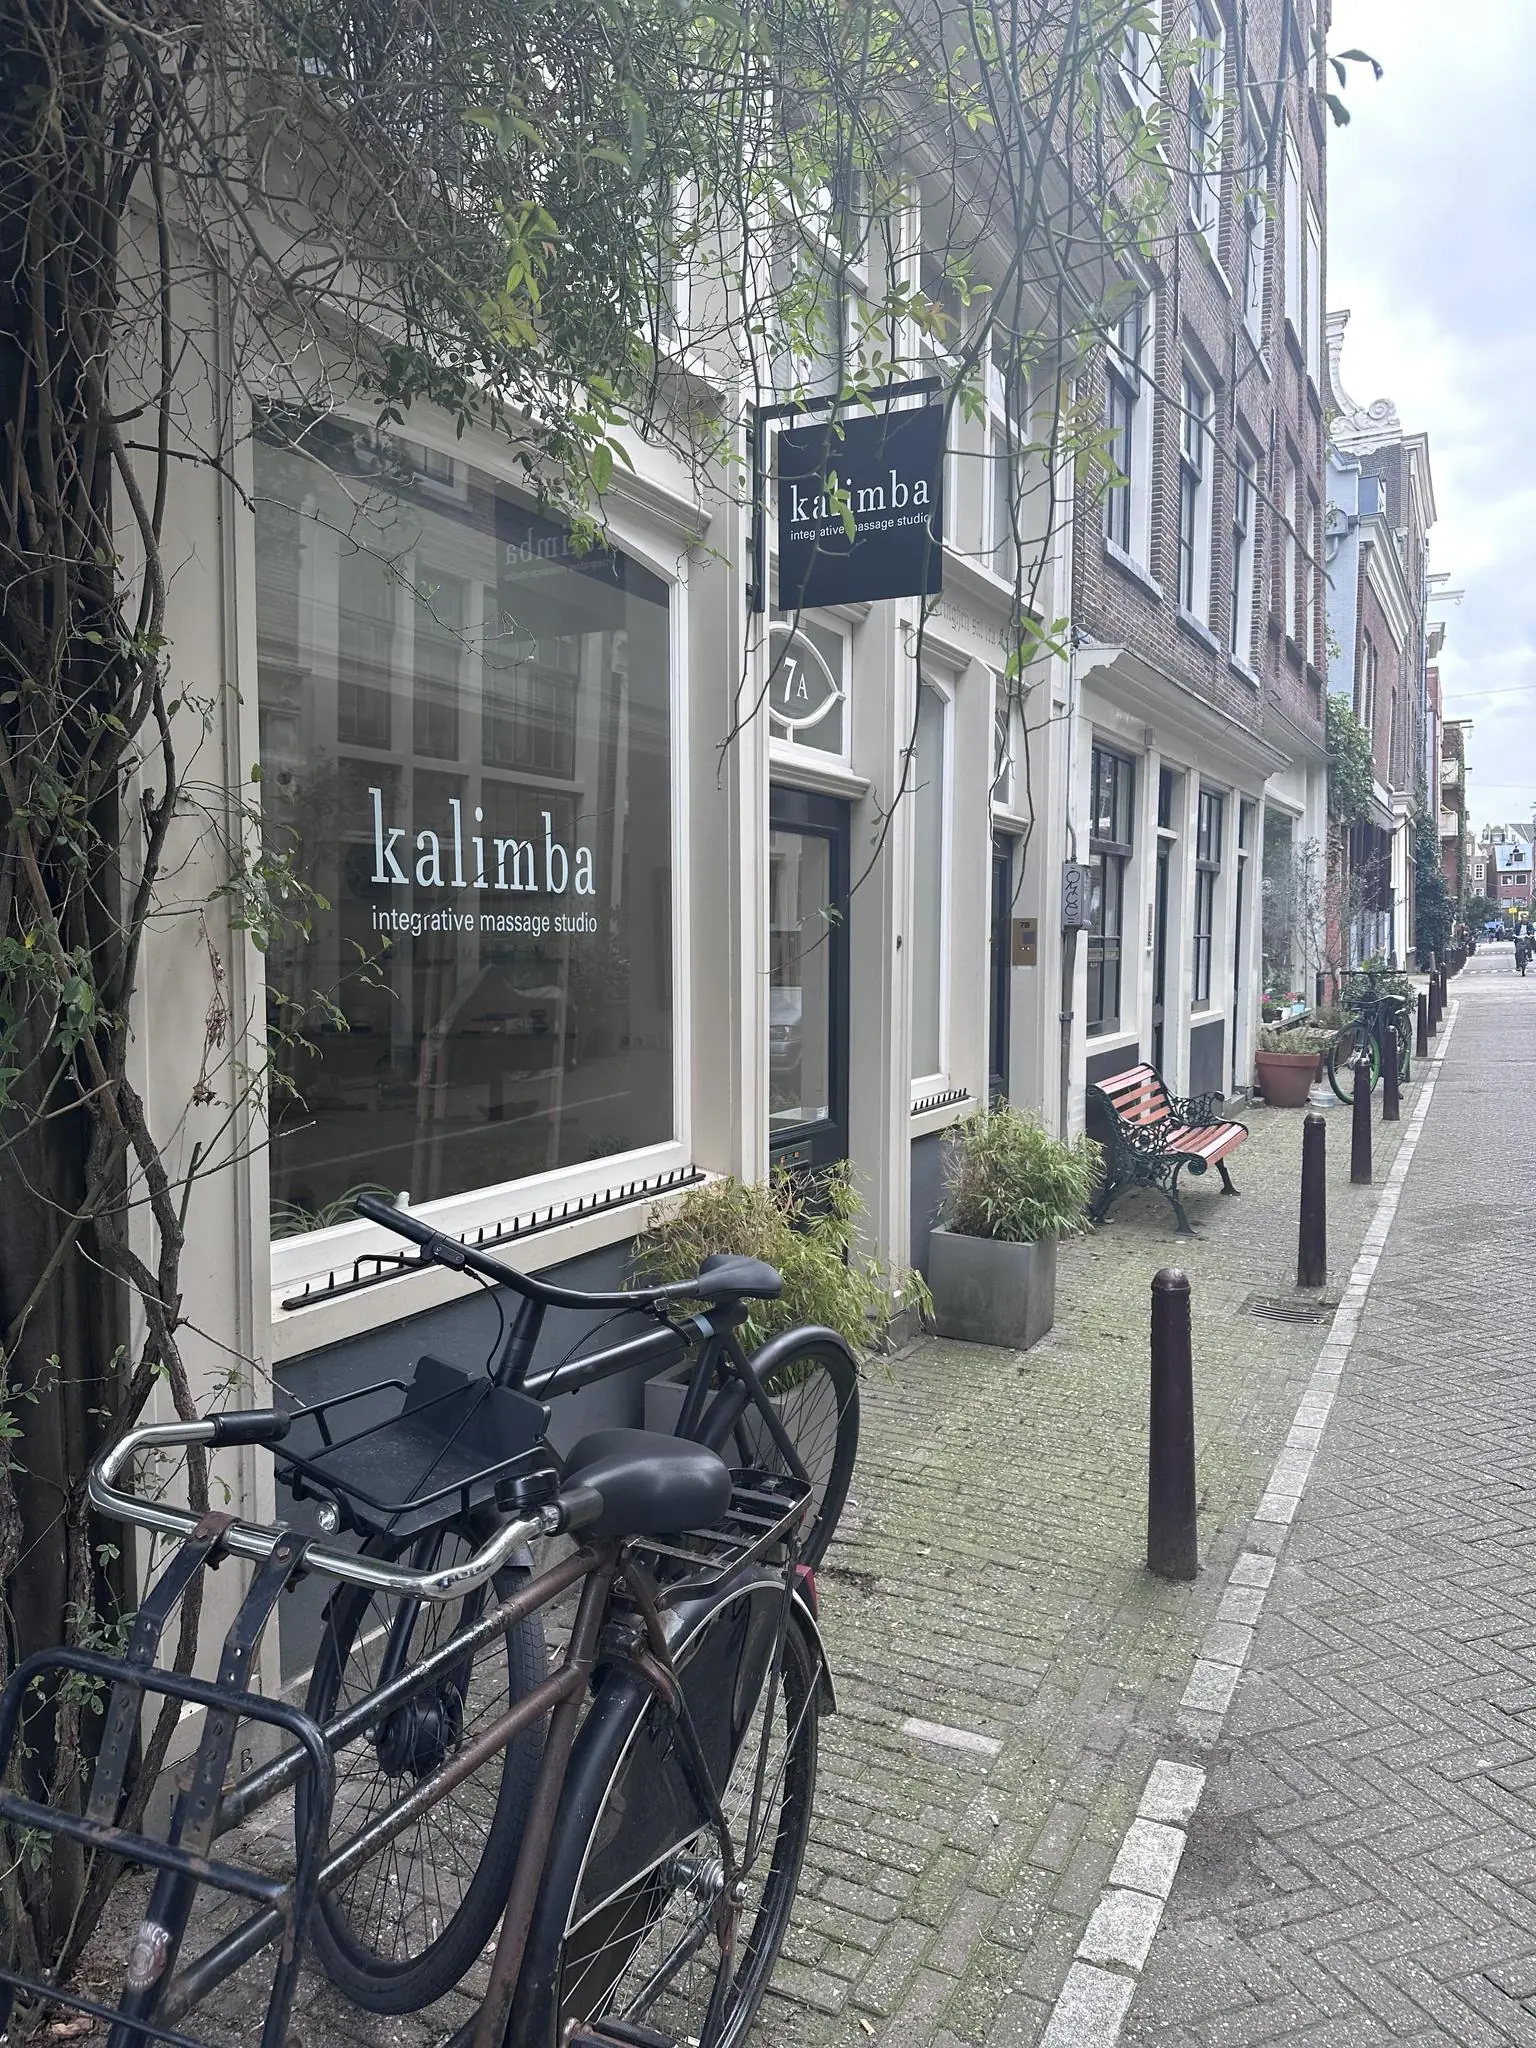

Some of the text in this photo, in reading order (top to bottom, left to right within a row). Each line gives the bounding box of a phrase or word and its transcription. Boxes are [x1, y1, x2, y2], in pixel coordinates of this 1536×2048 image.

[790, 525, 845, 541] integative
[845, 517, 894, 535] assage
[784, 656, 809, 703] 7A
[368, 787, 596, 895] kalimba
[372, 904, 598, 937] integrative massage studio
